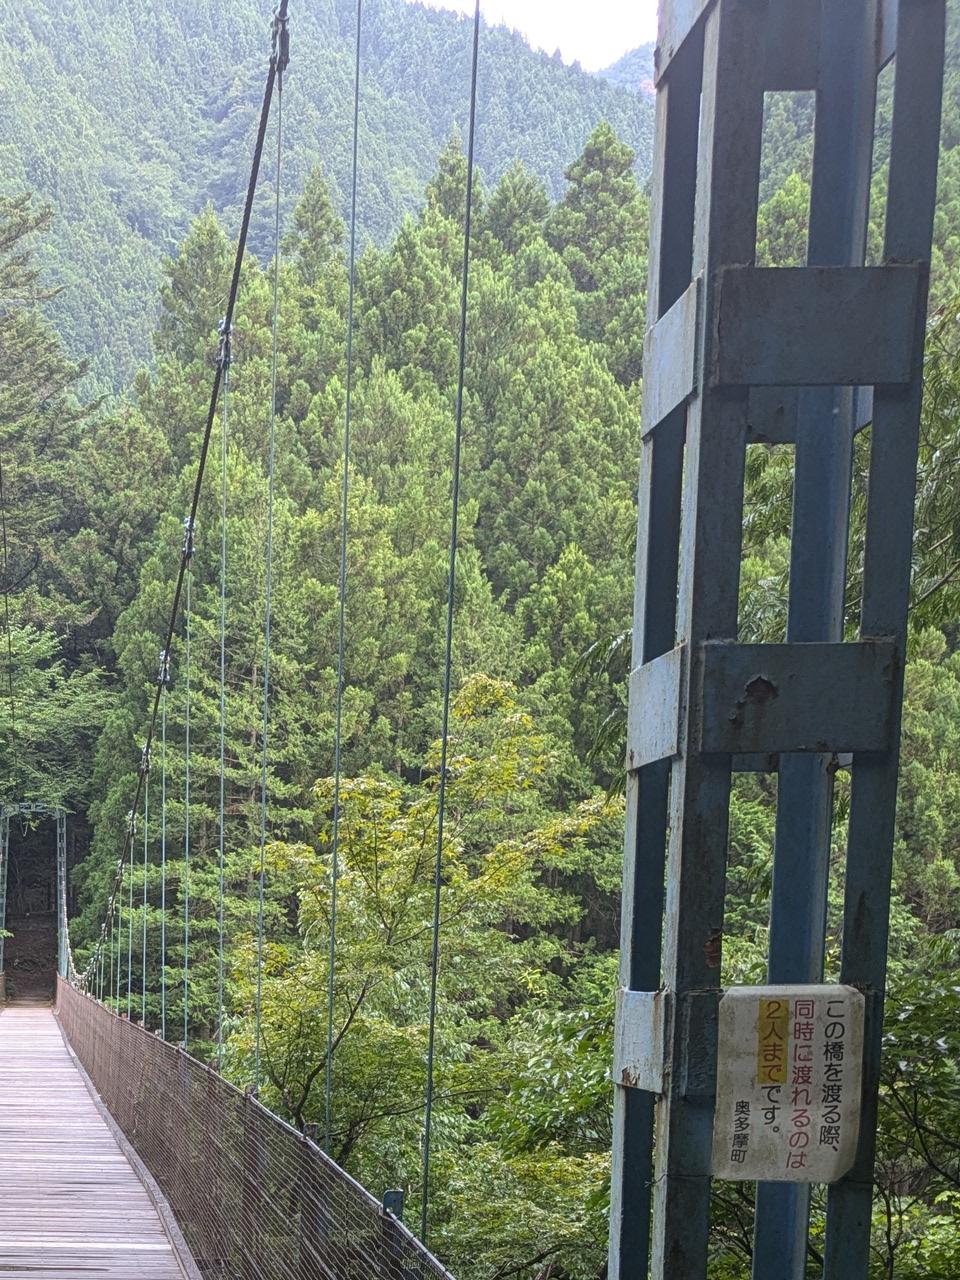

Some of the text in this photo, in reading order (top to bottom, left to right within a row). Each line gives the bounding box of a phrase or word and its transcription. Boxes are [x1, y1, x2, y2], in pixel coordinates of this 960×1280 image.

[730, 1100, 751, 1163] 奥多摩町
[760, 1001, 783, 1133] 2人までです。
[786, 1000, 815, 1169] 同時に渡れるのは
[820, 1000, 845, 1152] この橋を渡る際、
